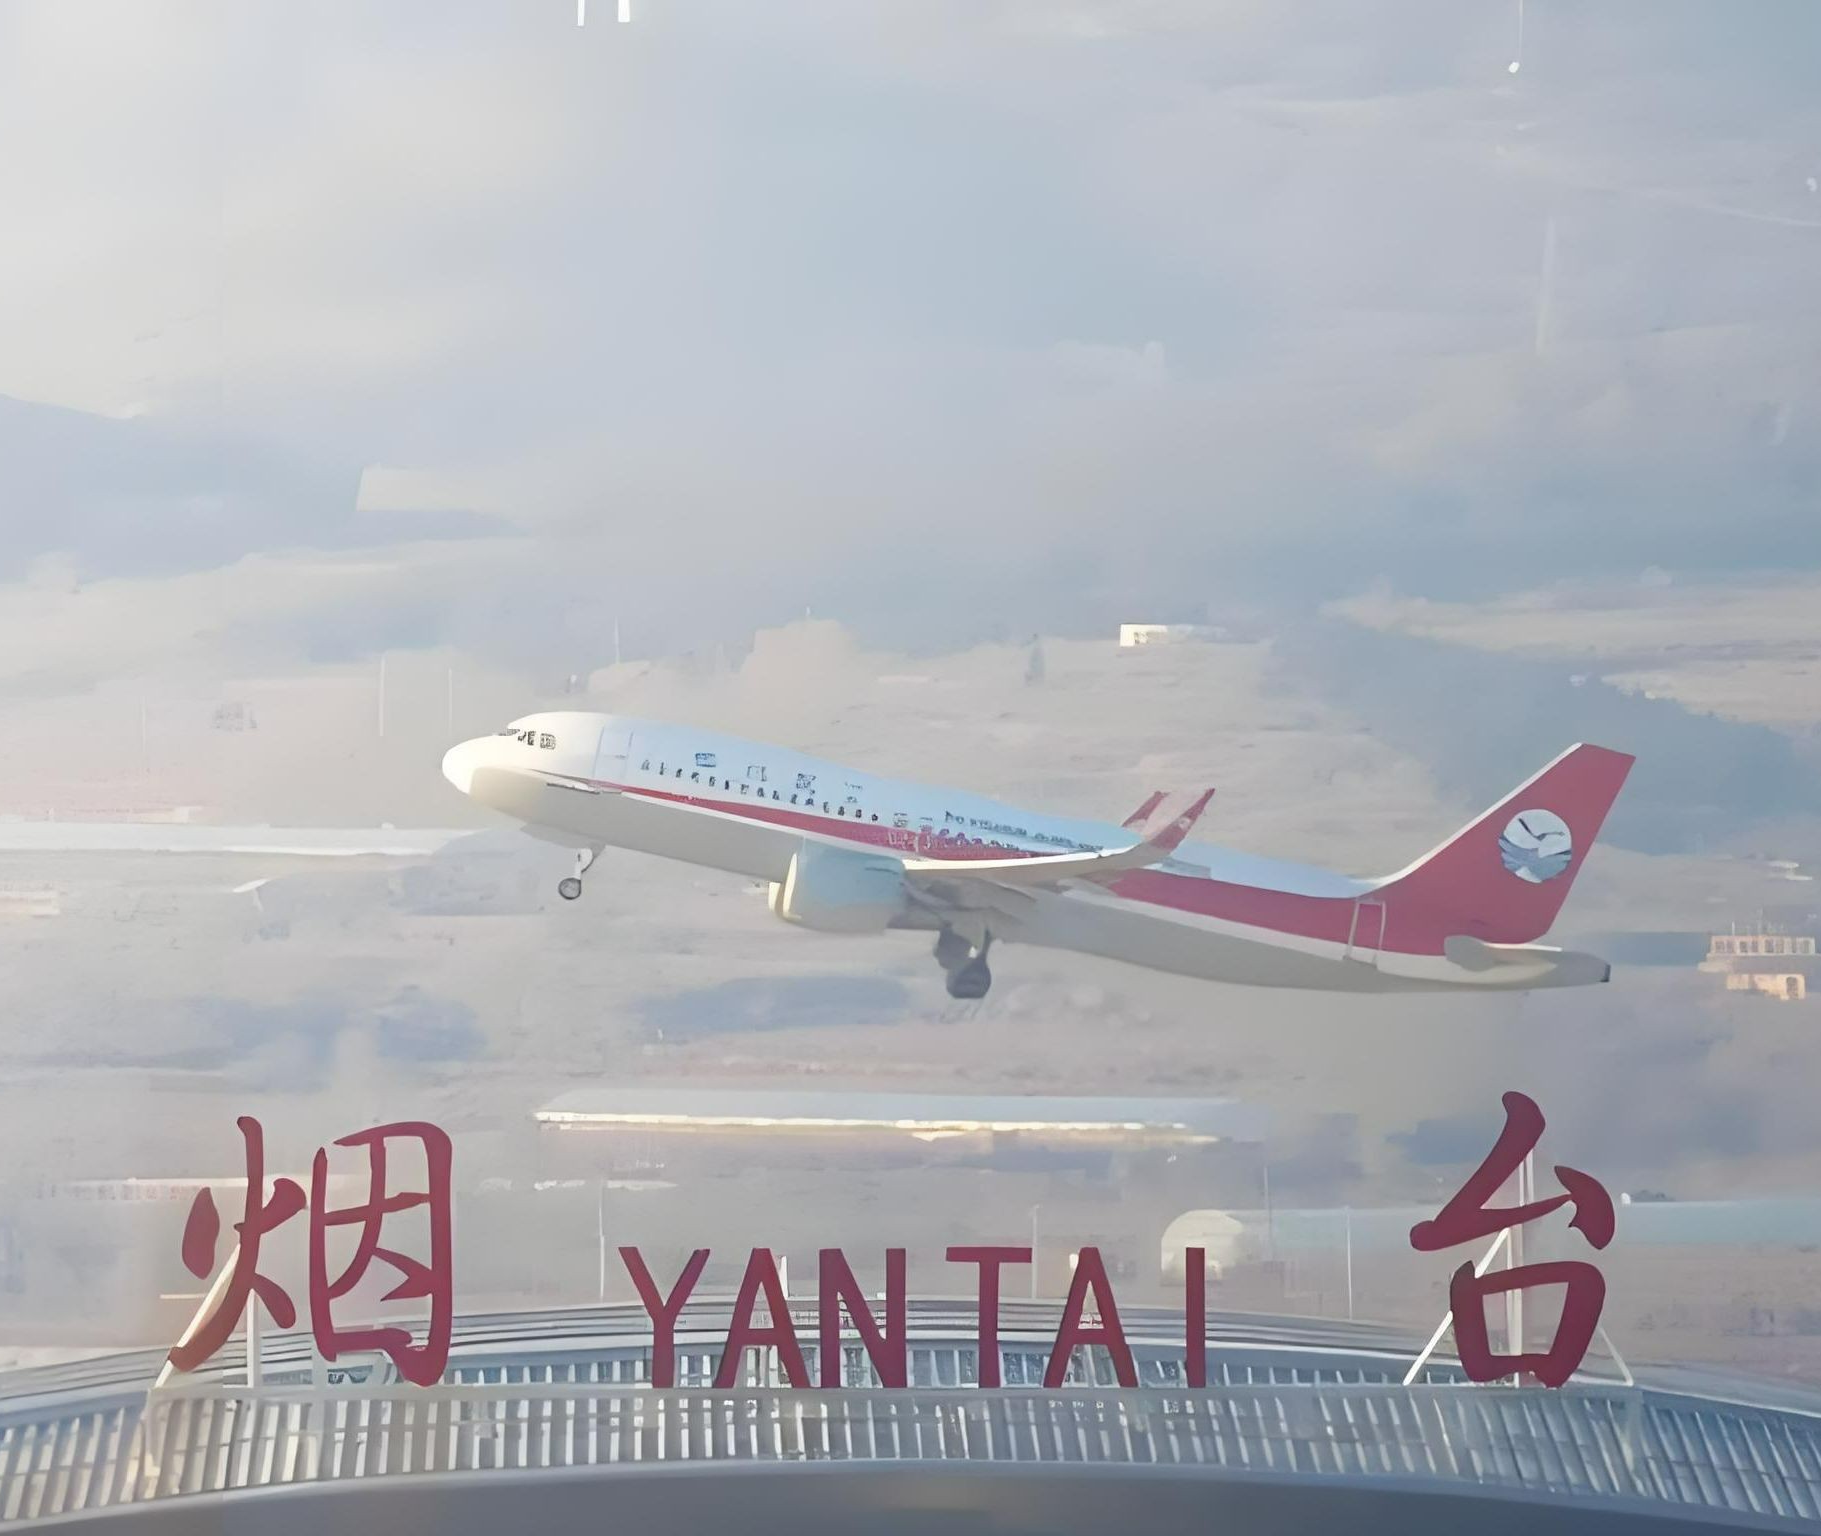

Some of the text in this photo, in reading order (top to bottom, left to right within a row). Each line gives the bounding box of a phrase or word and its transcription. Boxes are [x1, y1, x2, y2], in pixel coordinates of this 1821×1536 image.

[169, 1091, 1615, 1389] 烟 YANTAI 台
